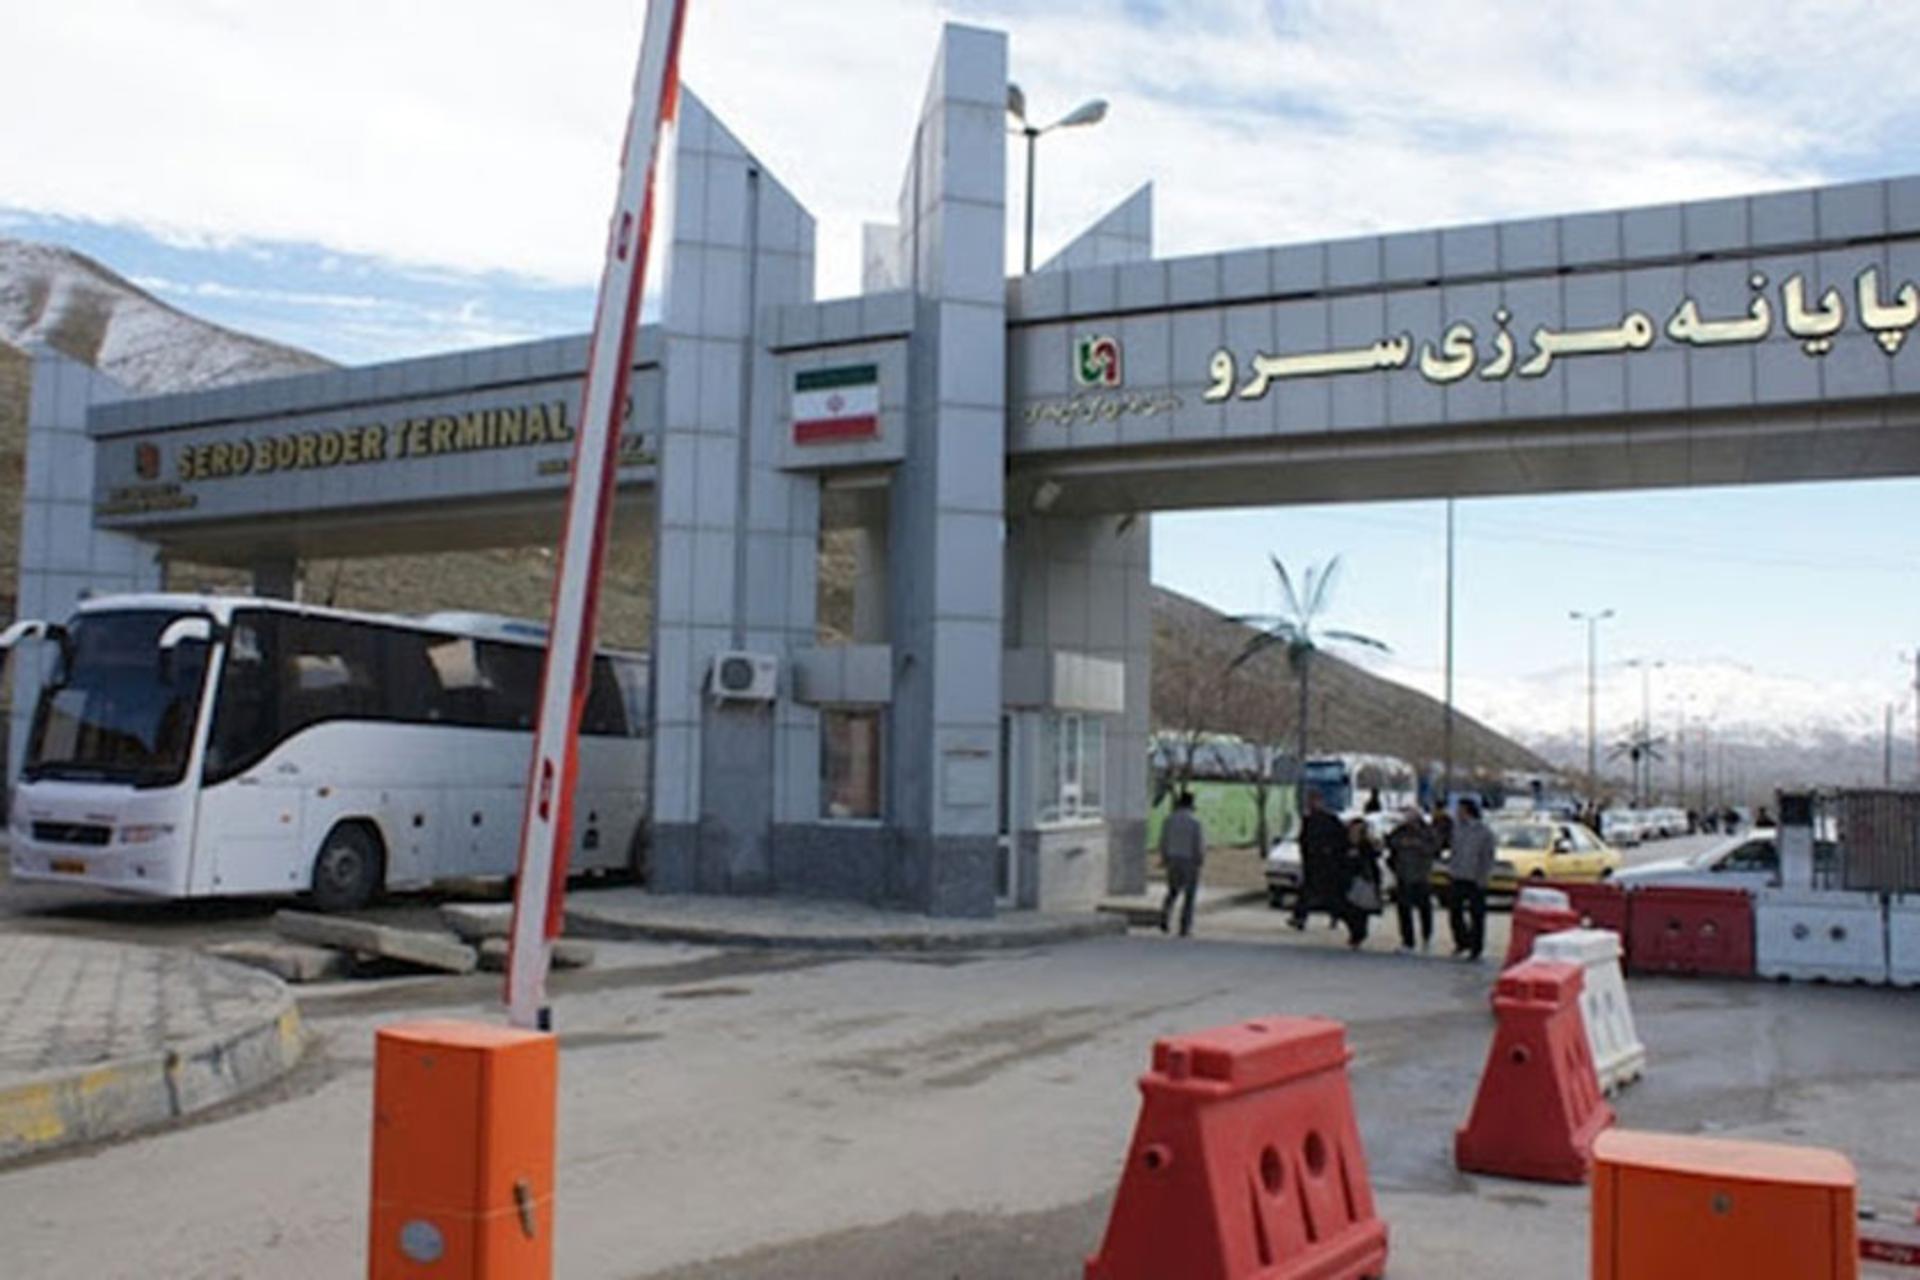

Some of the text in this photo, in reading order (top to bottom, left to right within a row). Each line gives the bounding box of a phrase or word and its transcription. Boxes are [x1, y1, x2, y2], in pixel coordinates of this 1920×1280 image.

[1201, 264, 1920, 402] پایانه مرزی سرو
[178, 443, 252, 480] SERO
[253, 424, 386, 474] BORDER
[394, 401, 573, 457] TERMINAL
